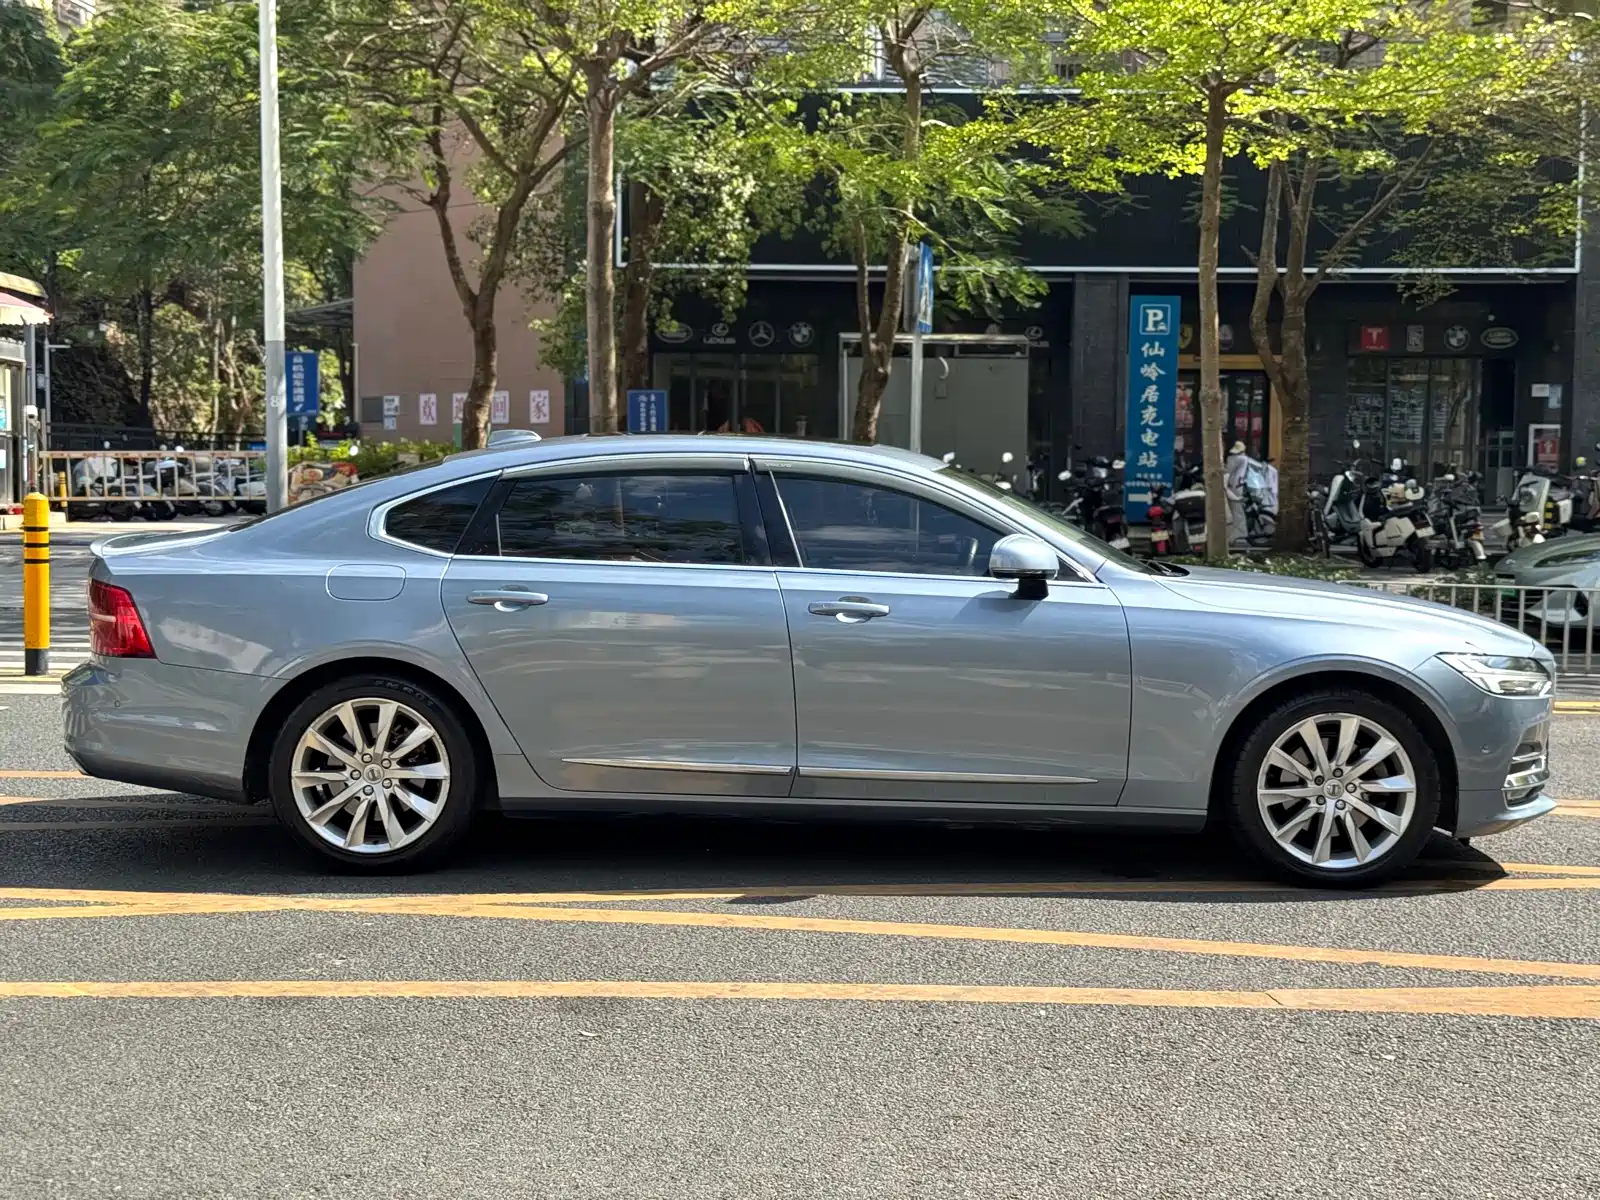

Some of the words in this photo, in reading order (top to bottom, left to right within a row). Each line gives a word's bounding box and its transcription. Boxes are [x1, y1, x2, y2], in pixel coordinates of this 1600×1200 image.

[1145, 308, 1164, 332] P
[1138, 341, 1167, 468] 仙岭居充电站
